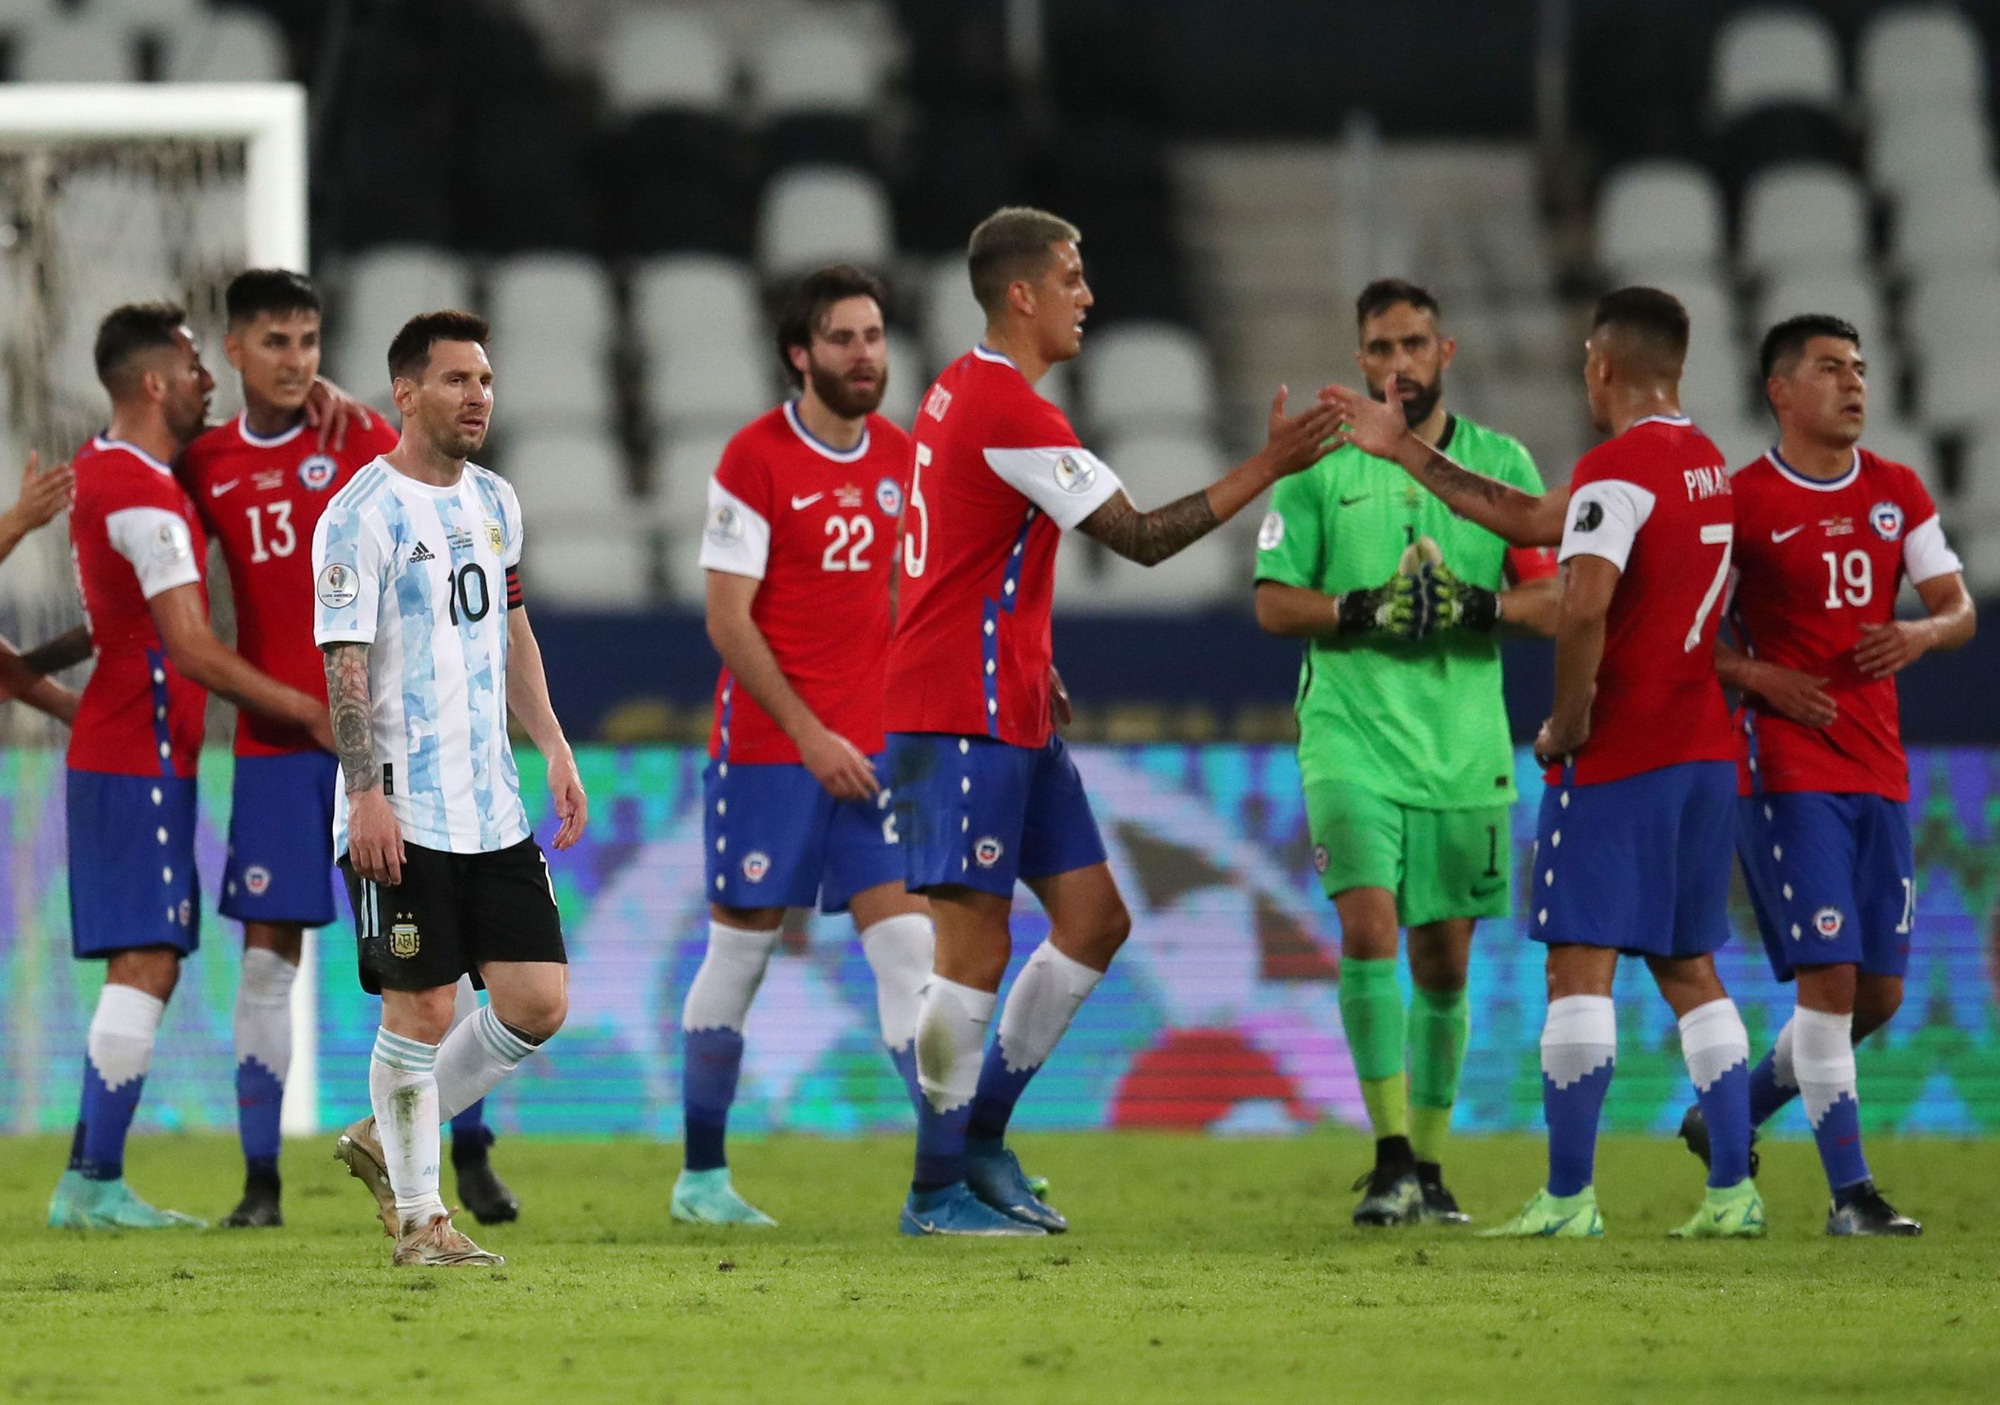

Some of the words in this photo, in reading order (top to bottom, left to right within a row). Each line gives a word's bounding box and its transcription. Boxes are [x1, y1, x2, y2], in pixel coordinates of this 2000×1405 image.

[246, 500, 297, 563] 13
[904, 442, 933, 578] 5
[410, 553, 435, 563] adidas
[821, 515, 874, 571] 22
[447, 562, 490, 626] 10
[1684, 523, 1734, 653] 7
[1822, 549, 1873, 609] 19
[1483, 824, 1499, 877] 1
